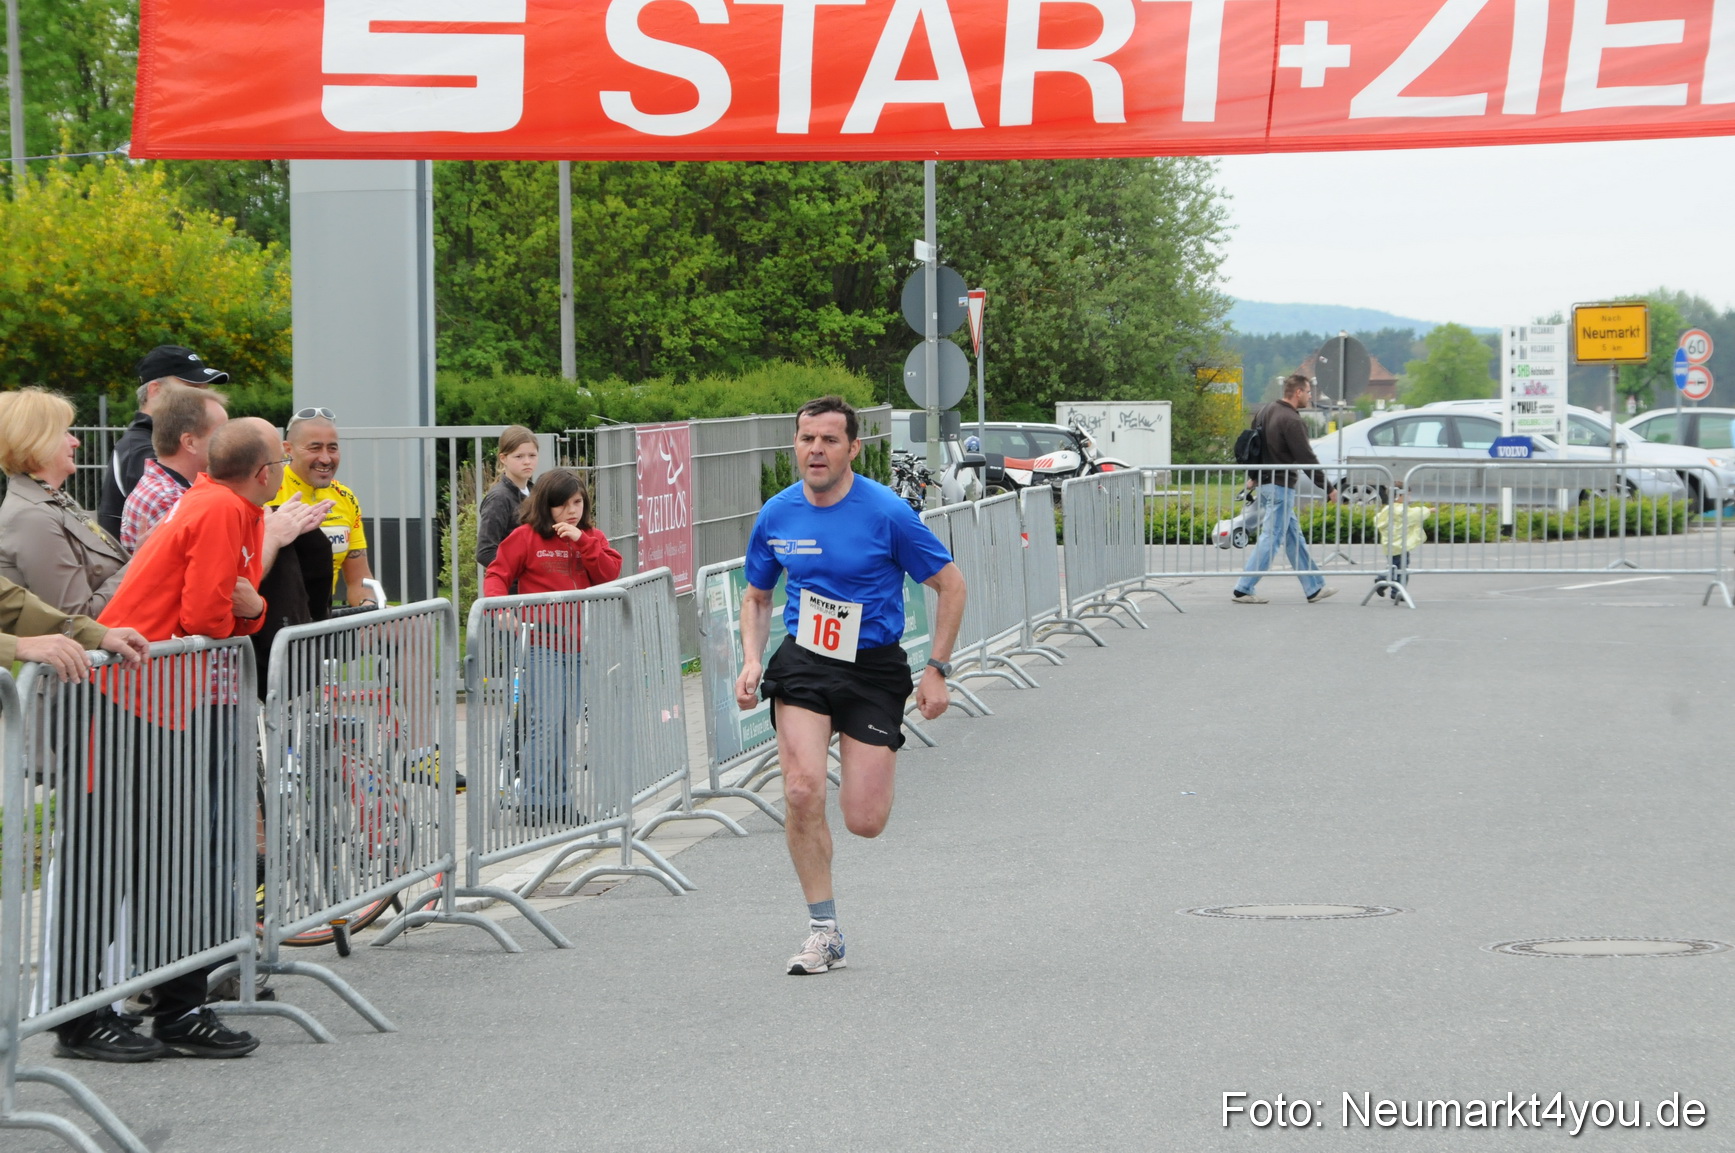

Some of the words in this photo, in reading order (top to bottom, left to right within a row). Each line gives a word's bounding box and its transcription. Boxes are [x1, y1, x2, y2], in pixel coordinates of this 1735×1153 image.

[599, 0, 1226, 136] START
[1601, 314, 1622, 322] Nach
[1582, 325, 1641, 340] Neumarkt
[1602, 343, 1608, 352] 5
[1612, 344, 1623, 352] km
[1687, 339, 1707, 355] 60
[1497, 445, 1528, 457] VOLVO
[647, 490, 687, 535] ZEITLOS
[809, 596, 836, 611] MEYER
[809, 602, 836, 617] WERBUNG
[813, 613, 842, 651] 16
